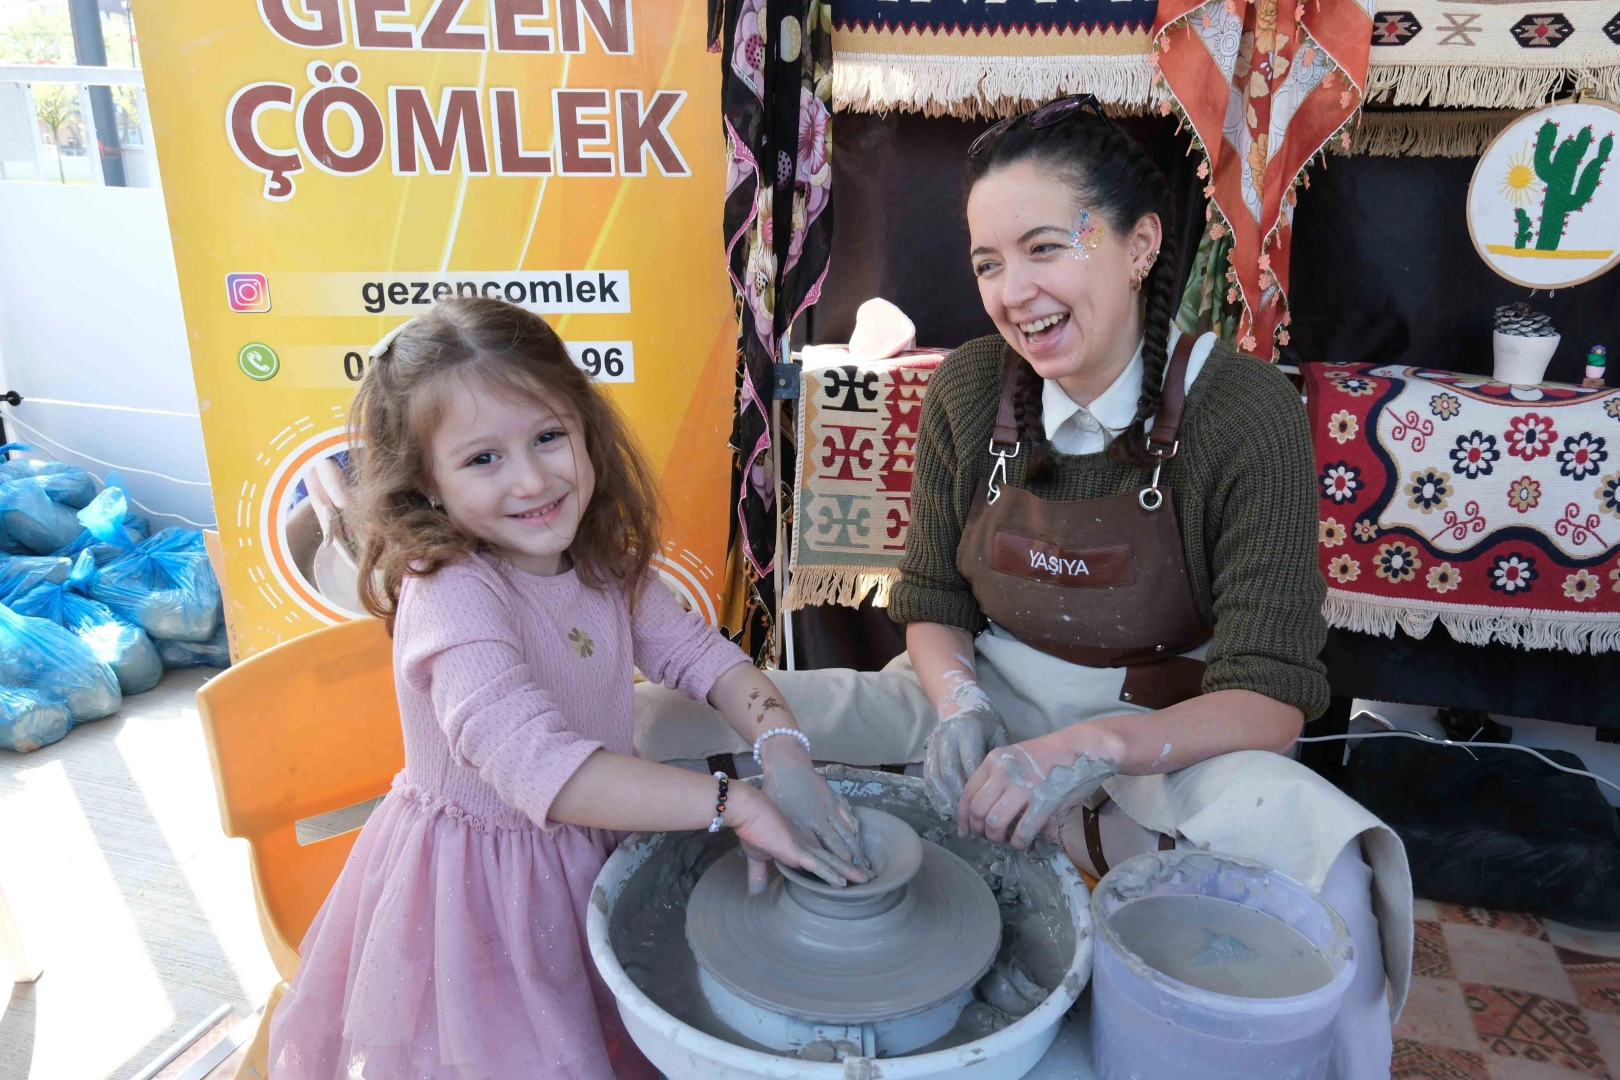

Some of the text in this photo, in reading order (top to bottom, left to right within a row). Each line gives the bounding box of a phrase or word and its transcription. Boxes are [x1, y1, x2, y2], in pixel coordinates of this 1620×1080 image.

[257, 0, 634, 53] GEZEN
[226, 61, 692, 201] ÇÖMLEK
[361, 272, 620, 313] gezencomlek
[581, 347, 624, 377] 96
[1029, 550, 1090, 576] YAŞIYA
